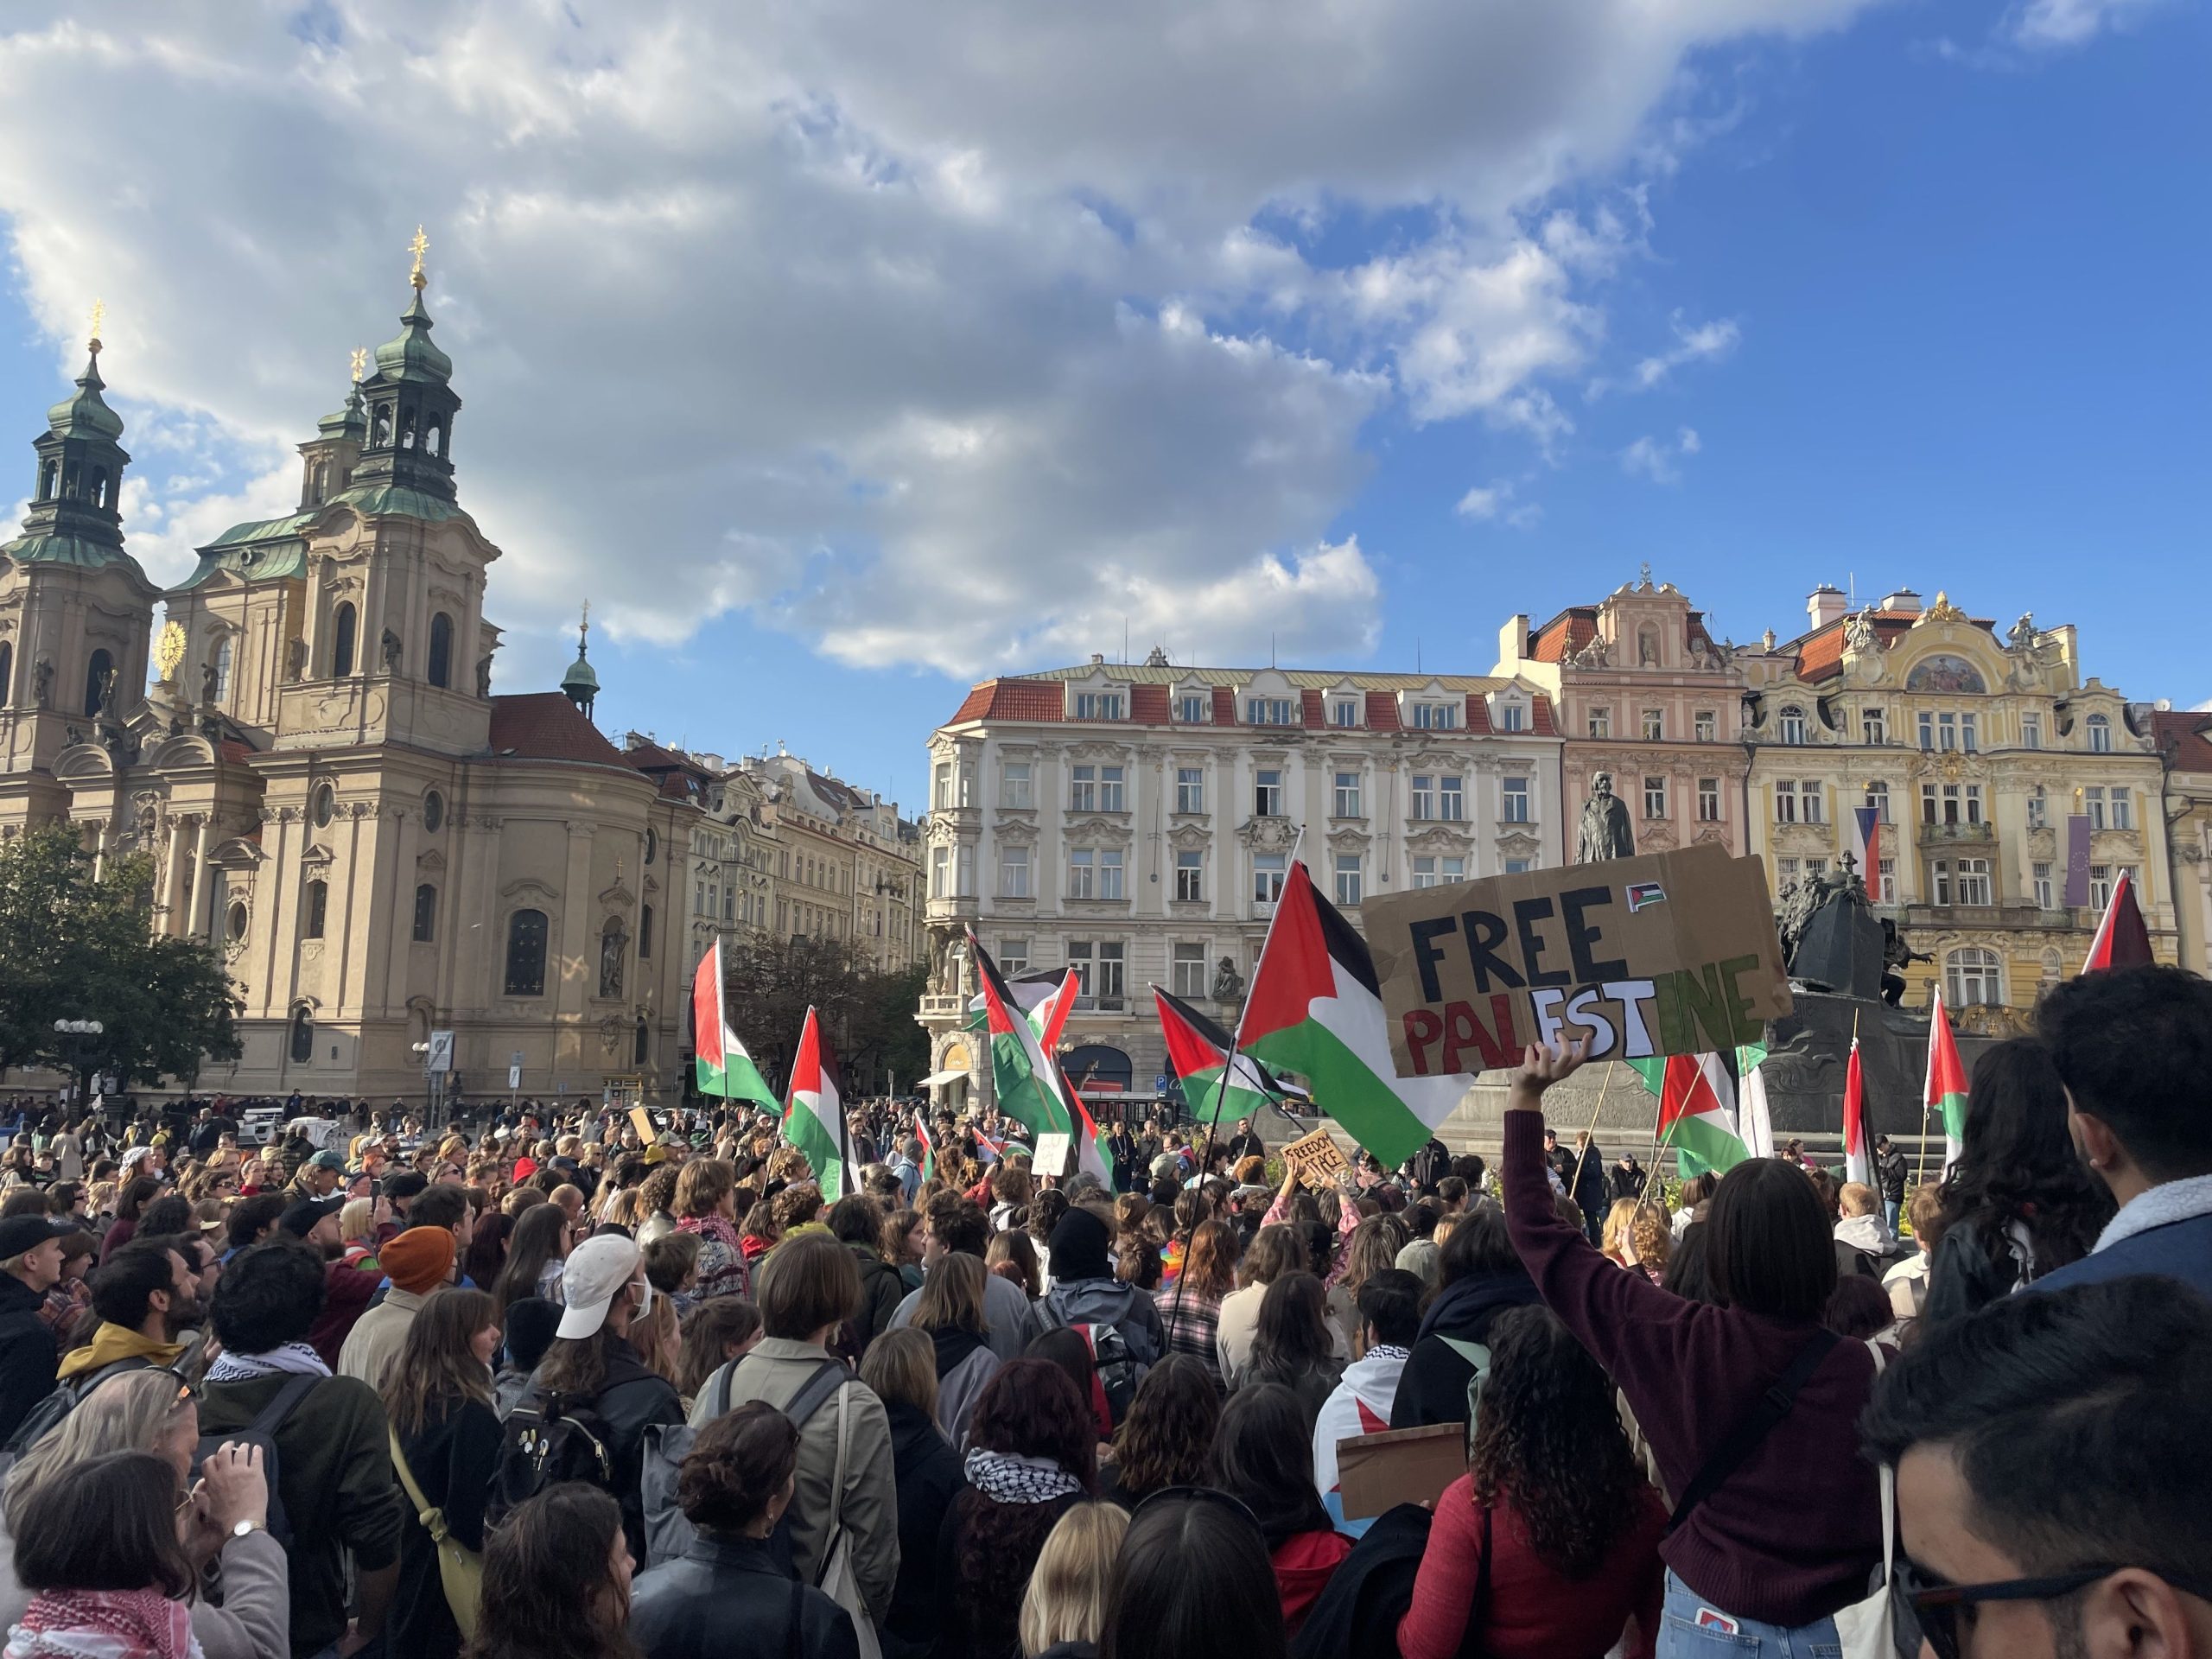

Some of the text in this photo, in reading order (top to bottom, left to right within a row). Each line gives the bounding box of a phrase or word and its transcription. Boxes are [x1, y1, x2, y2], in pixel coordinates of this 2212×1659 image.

[1408, 886, 1629, 1003] FREE
[1402, 954, 1764, 1075] PALESTINE
[1158, 1077, 1165, 1086] P
[1285, 1135, 1332, 1160] FREEDOM
